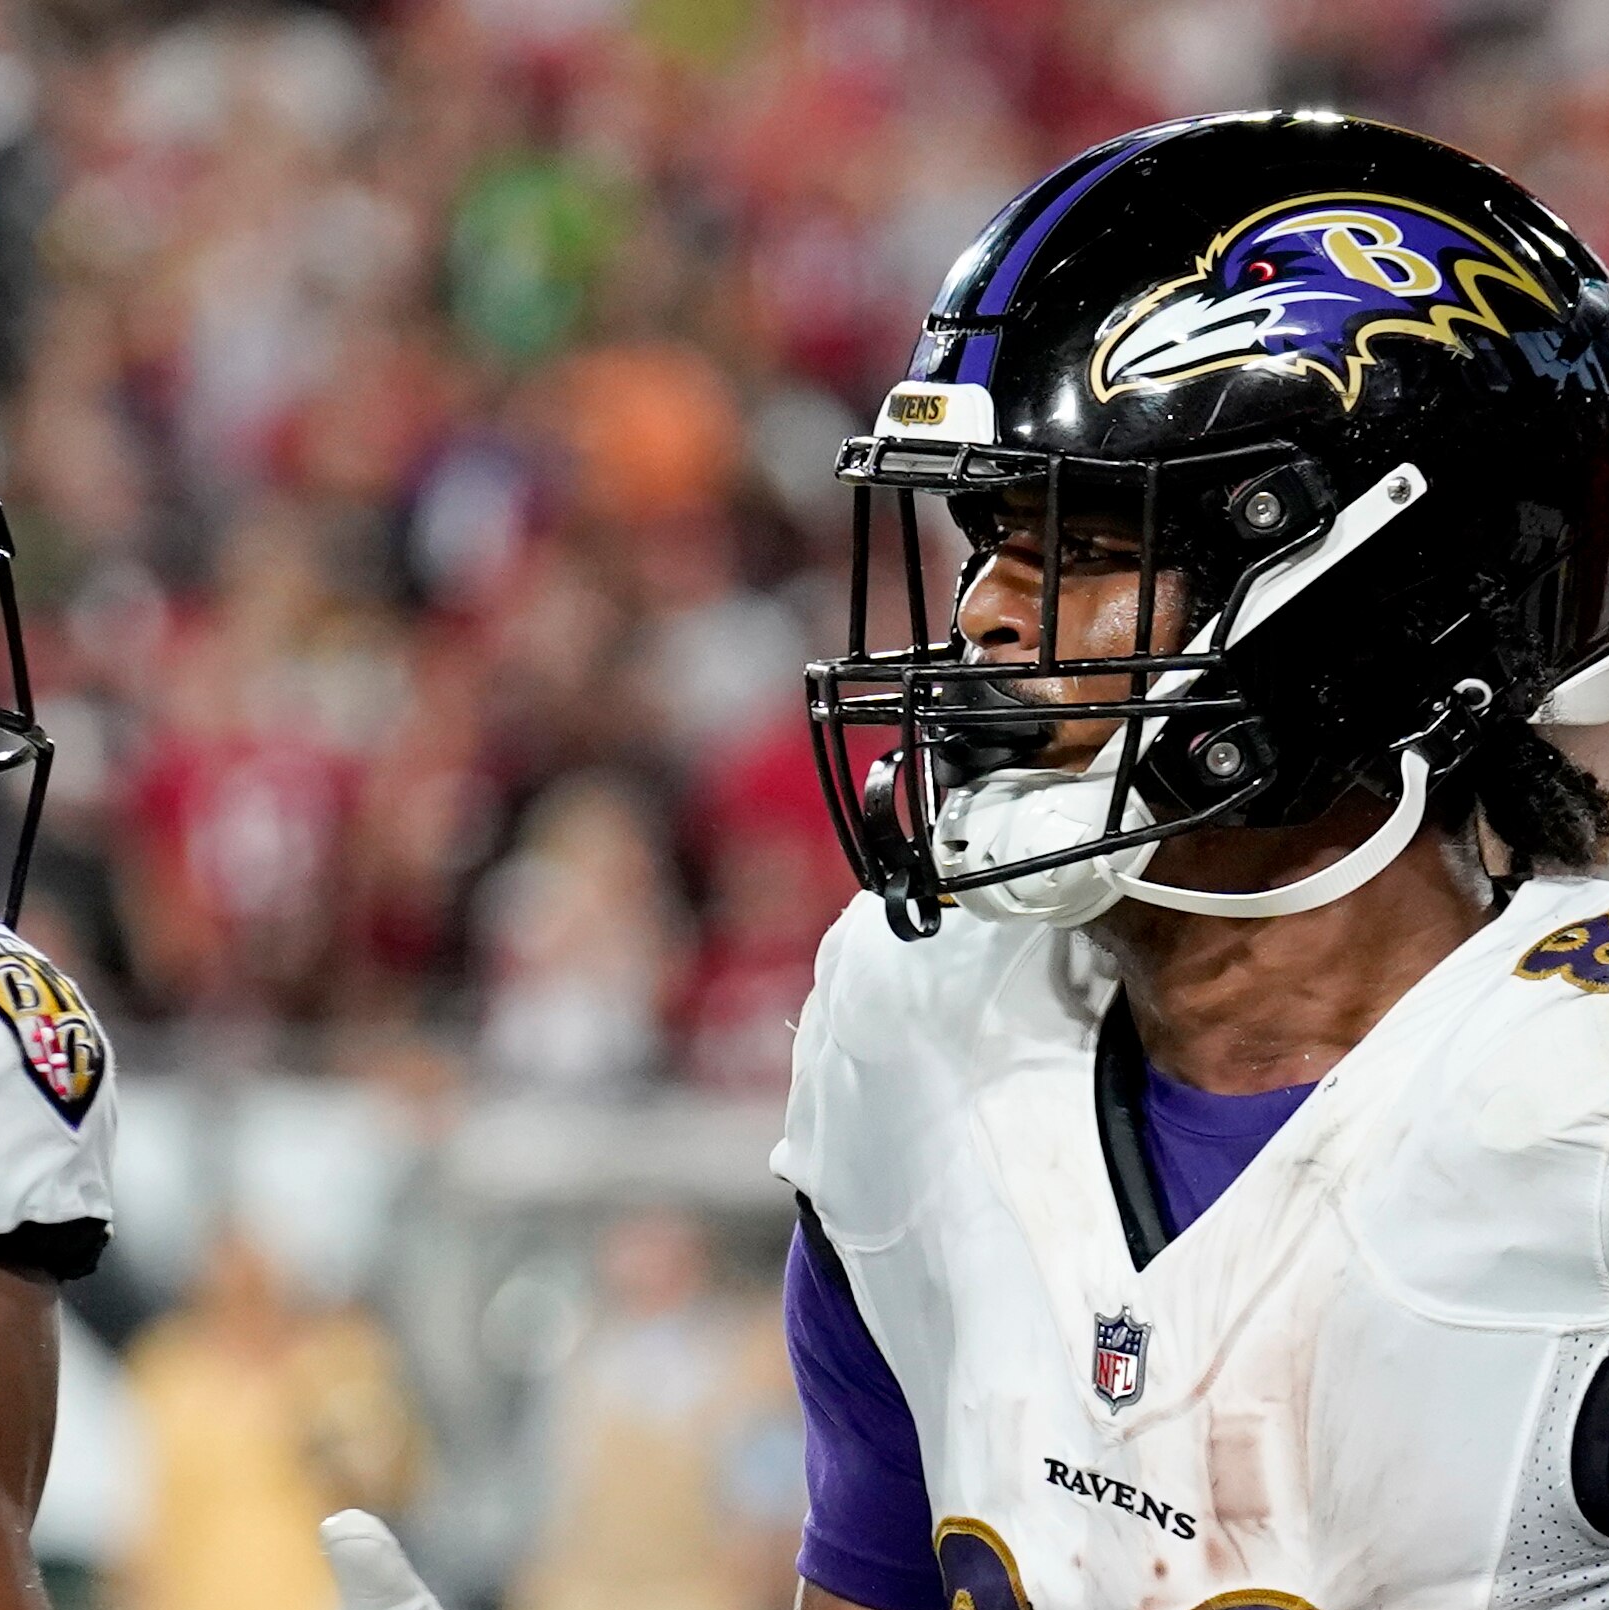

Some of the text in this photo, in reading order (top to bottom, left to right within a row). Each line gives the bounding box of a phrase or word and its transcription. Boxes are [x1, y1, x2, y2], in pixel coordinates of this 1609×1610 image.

[1253, 209, 1443, 297] B
[1096, 1350, 1133, 1395] NFL
[1043, 1457, 1197, 1540] RAVENS
